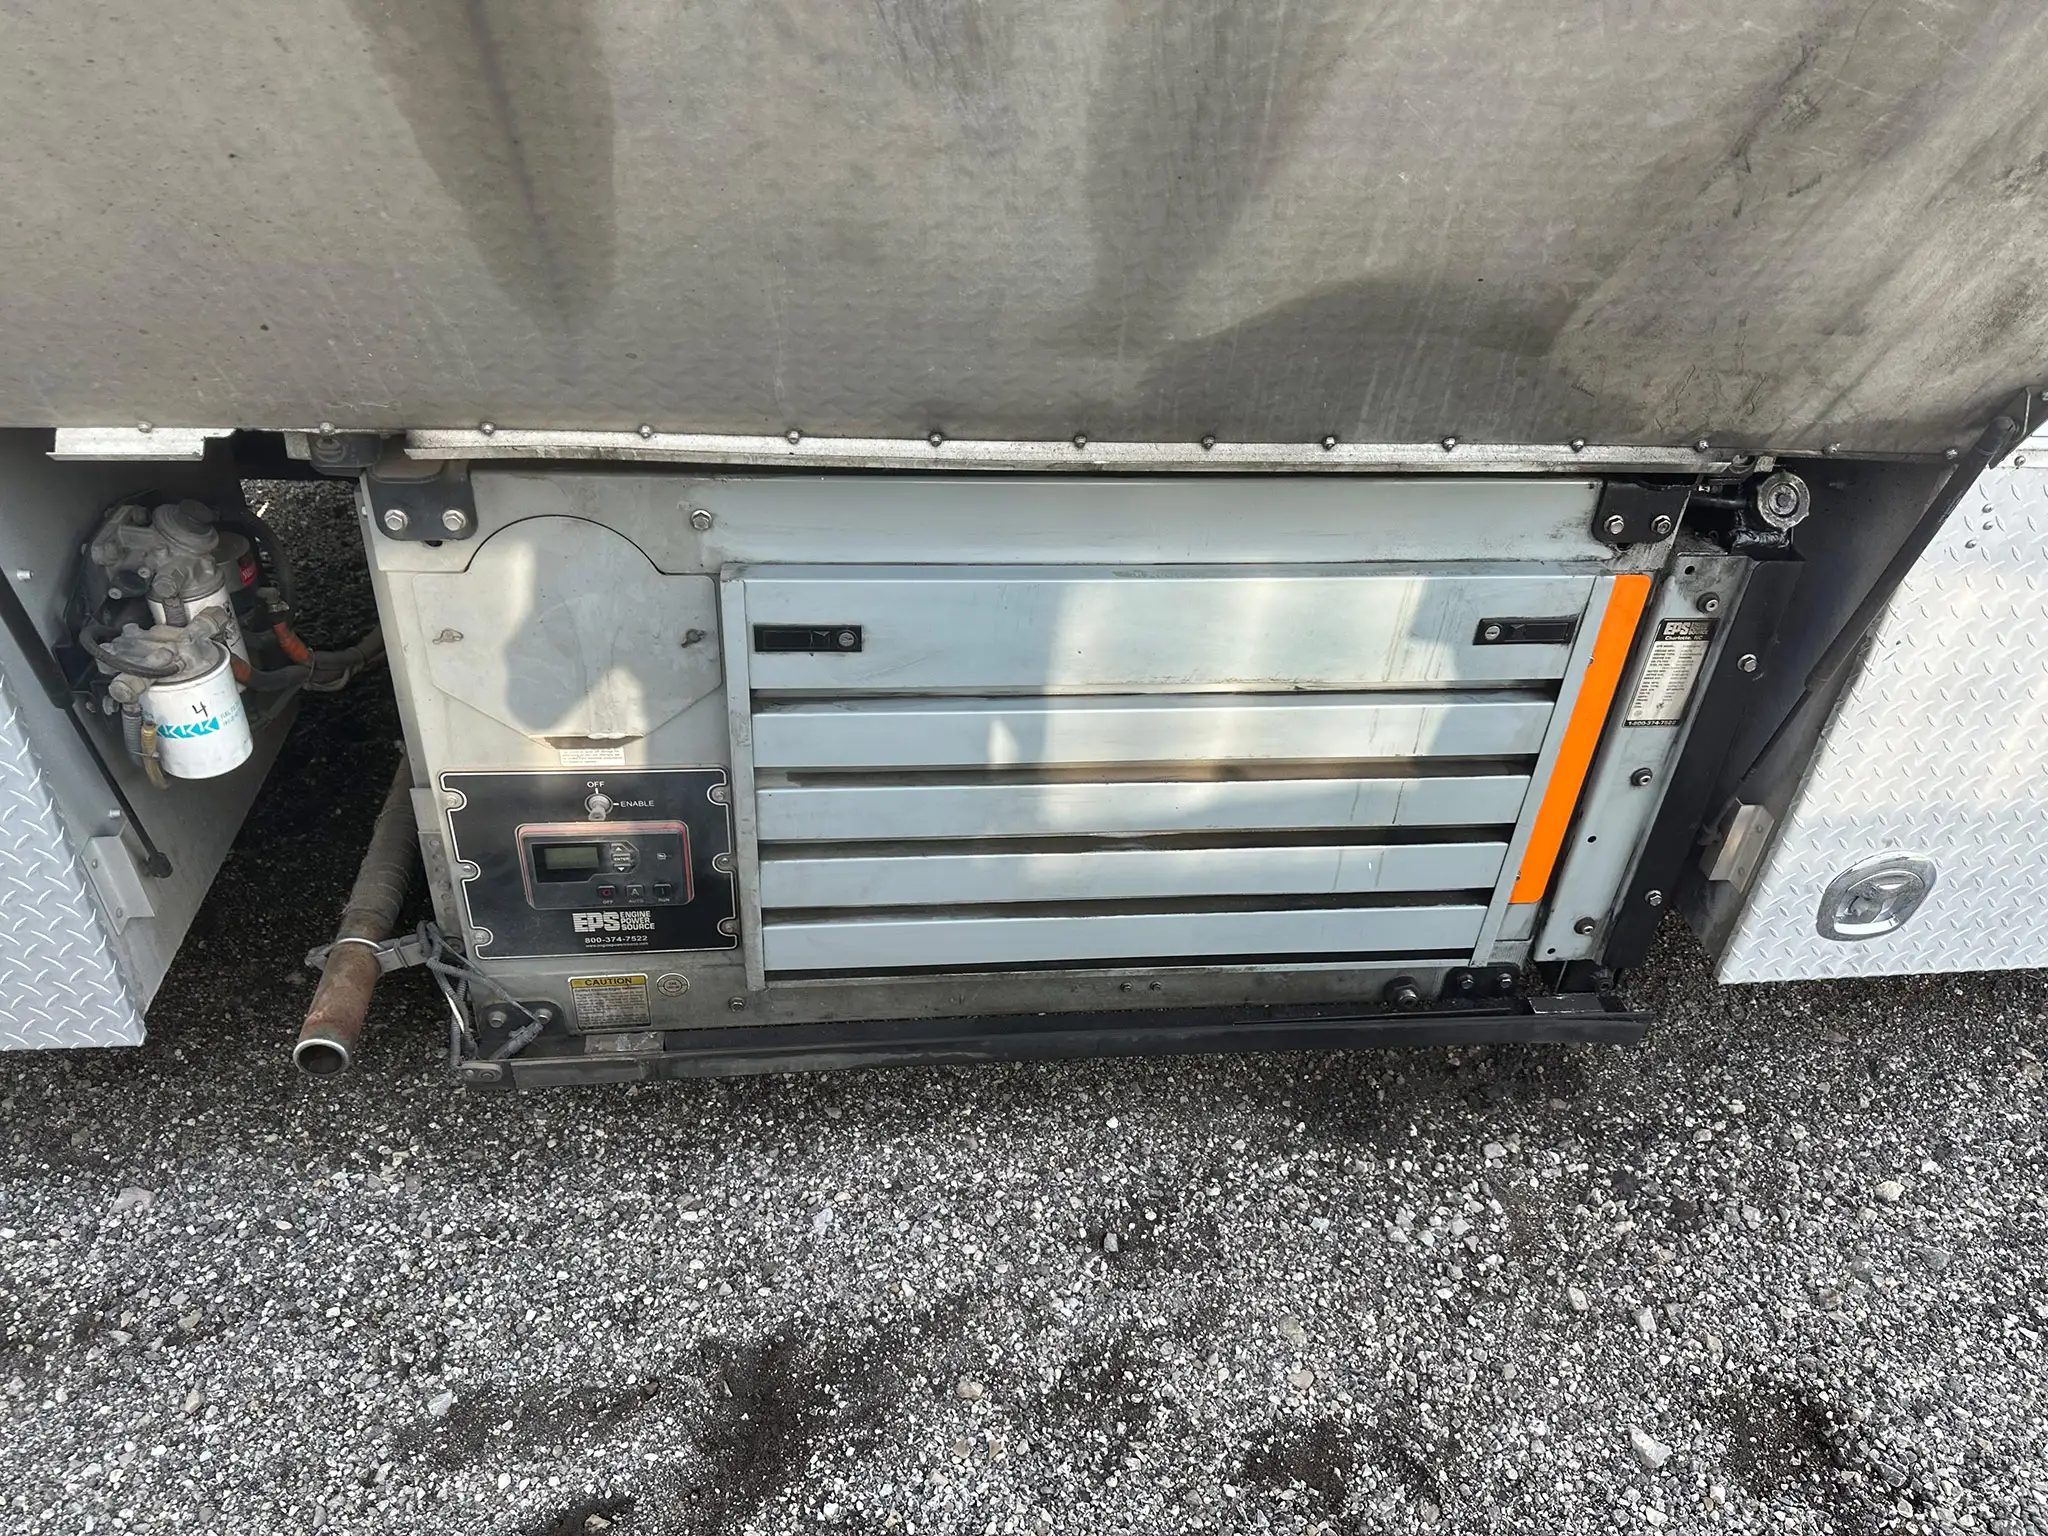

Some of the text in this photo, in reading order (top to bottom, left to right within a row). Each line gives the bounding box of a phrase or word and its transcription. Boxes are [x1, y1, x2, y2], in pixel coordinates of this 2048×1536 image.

[1664, 622, 1690, 635] EPS
[192, 701, 208, 717] 4
[620, 800, 655, 808] ENABLE
[572, 911, 620, 932] EPS
[621, 923, 656, 931] SOURCE
[584, 935, 648, 944] 800-374-7522
[584, 977, 632, 986] CAUTION
